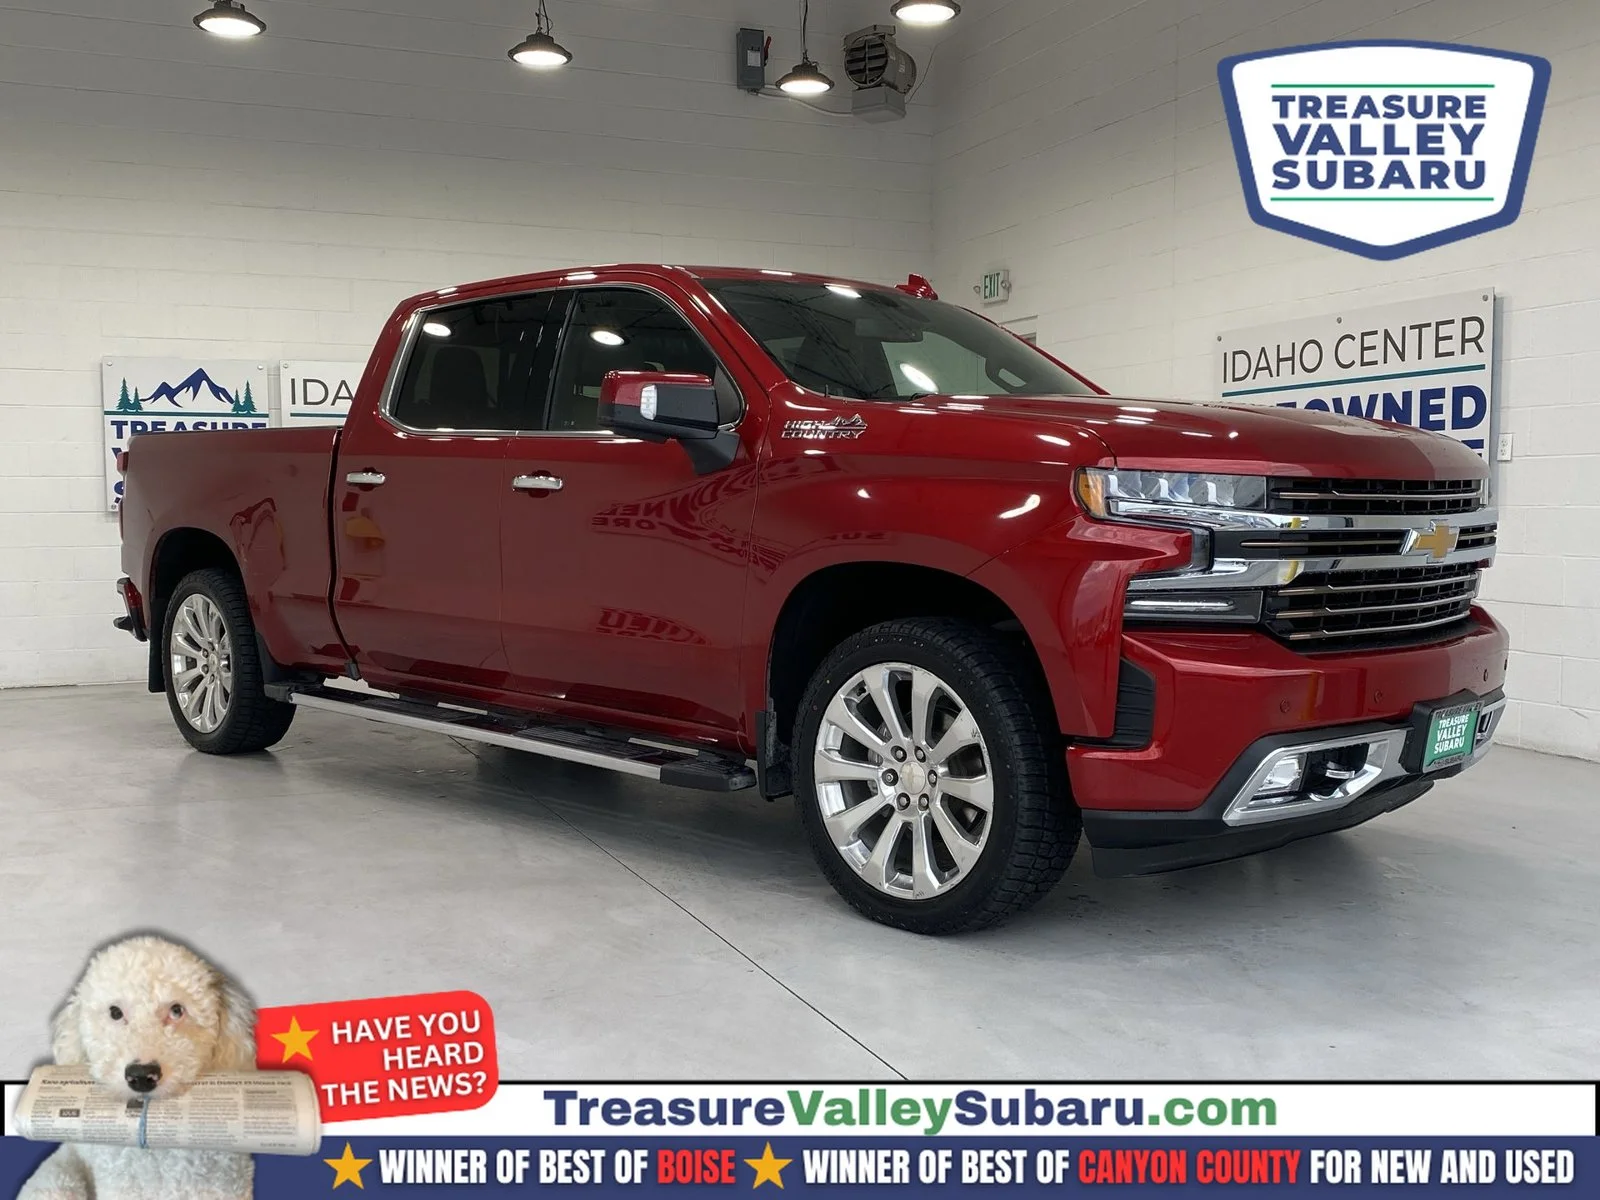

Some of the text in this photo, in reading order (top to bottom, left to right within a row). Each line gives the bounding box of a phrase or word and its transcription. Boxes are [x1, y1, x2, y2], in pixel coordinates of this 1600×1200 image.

[983, 272, 1001, 300] EXIT
[1222, 315, 1485, 384] IDAHO CENTER
[784, 420, 828, 430] HIGH
[781, 430, 866, 440] COUNTRY
[1438, 714, 1470, 729] TREASURE
[1437, 724, 1468, 742] VALLEY
[1434, 736, 1465, 755] SUBARU
